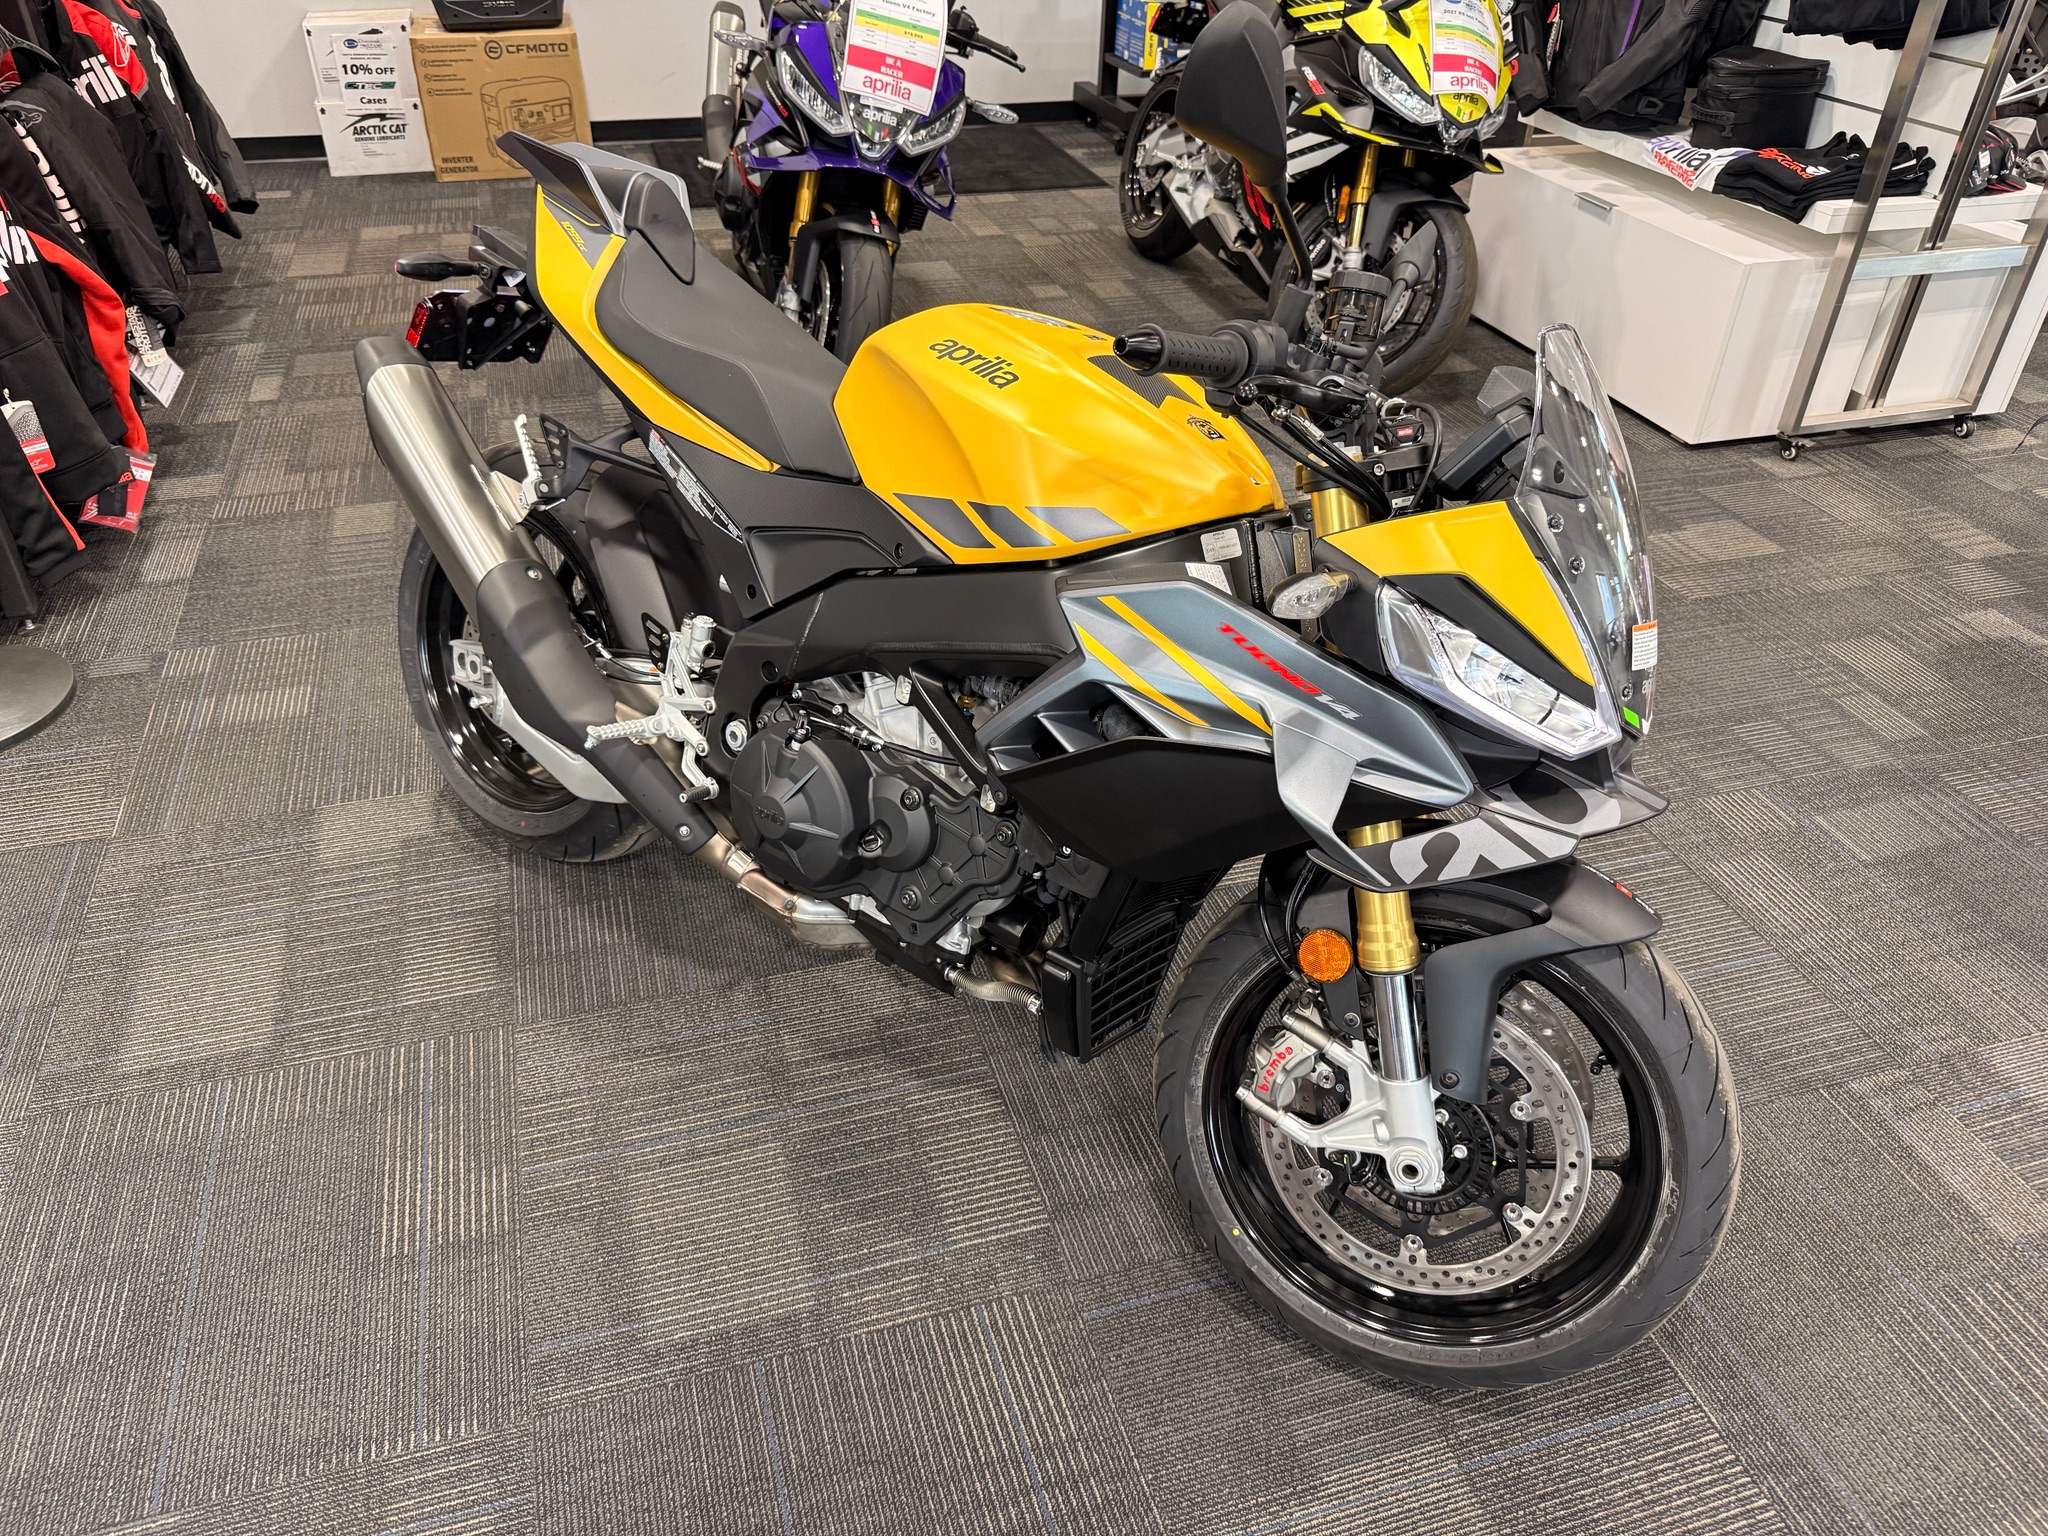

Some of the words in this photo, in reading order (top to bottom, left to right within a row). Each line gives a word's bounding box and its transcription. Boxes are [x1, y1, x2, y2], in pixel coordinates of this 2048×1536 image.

[505, 42, 569, 54] CFMOTO
[885, 56, 896, 65] BE
[896, 59, 902, 67] A
[341, 64, 373, 75] 10%
[375, 67, 395, 75] OFF
[880, 65, 904, 79] RACER
[1464, 65, 1482, 76] RACER
[862, 74, 912, 101] aprilia
[1450, 75, 1489, 96] aprilia
[360, 96, 388, 105] Cases
[862, 108, 898, 127] aprilia
[352, 125, 388, 136] ARCTIC
[389, 123, 407, 134] CAT
[441, 156, 474, 164] INVERTER
[1647, 136, 1712, 171] aprilia
[440, 166, 479, 174] GENERATOR
[929, 338, 1020, 390] aprilia
[1217, 621, 1324, 696] TUONO
[1313, 692, 1363, 721] V4
[1257, 1045, 1294, 1093] brembo
